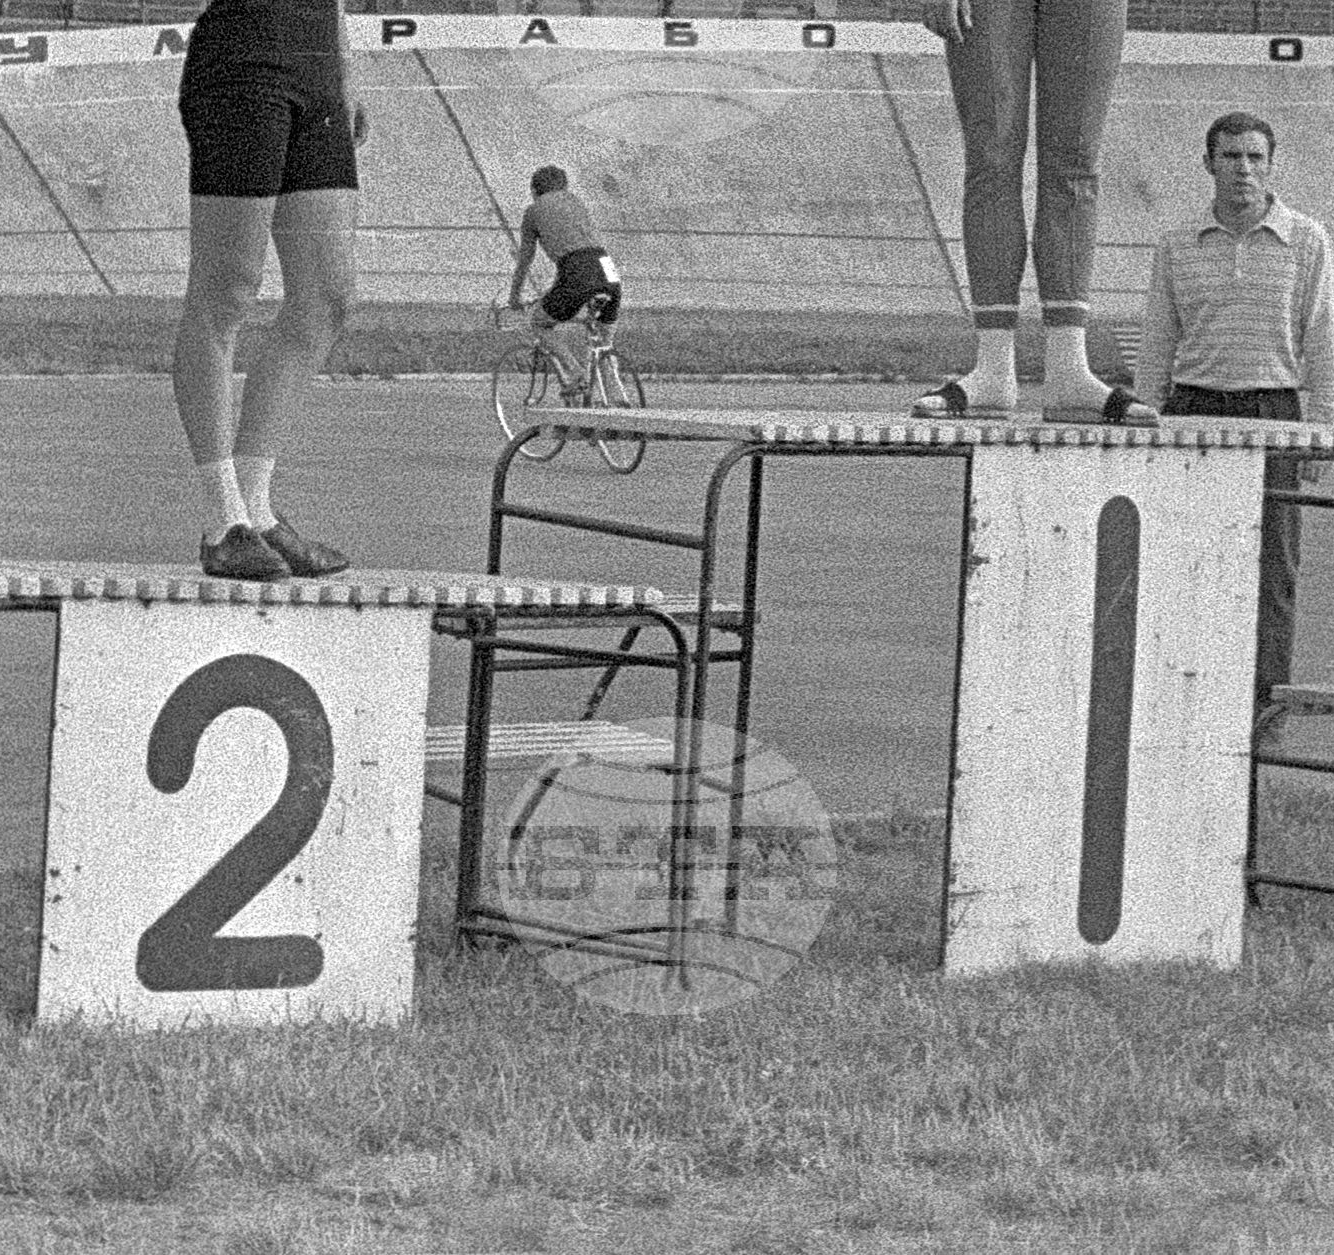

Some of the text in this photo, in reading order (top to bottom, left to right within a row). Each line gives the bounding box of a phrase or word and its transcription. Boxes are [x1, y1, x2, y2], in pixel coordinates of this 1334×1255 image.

[381, 18, 837, 48] РАБО
[135, 653, 335, 993] 2
[1077, 494, 1141, 945] 1
